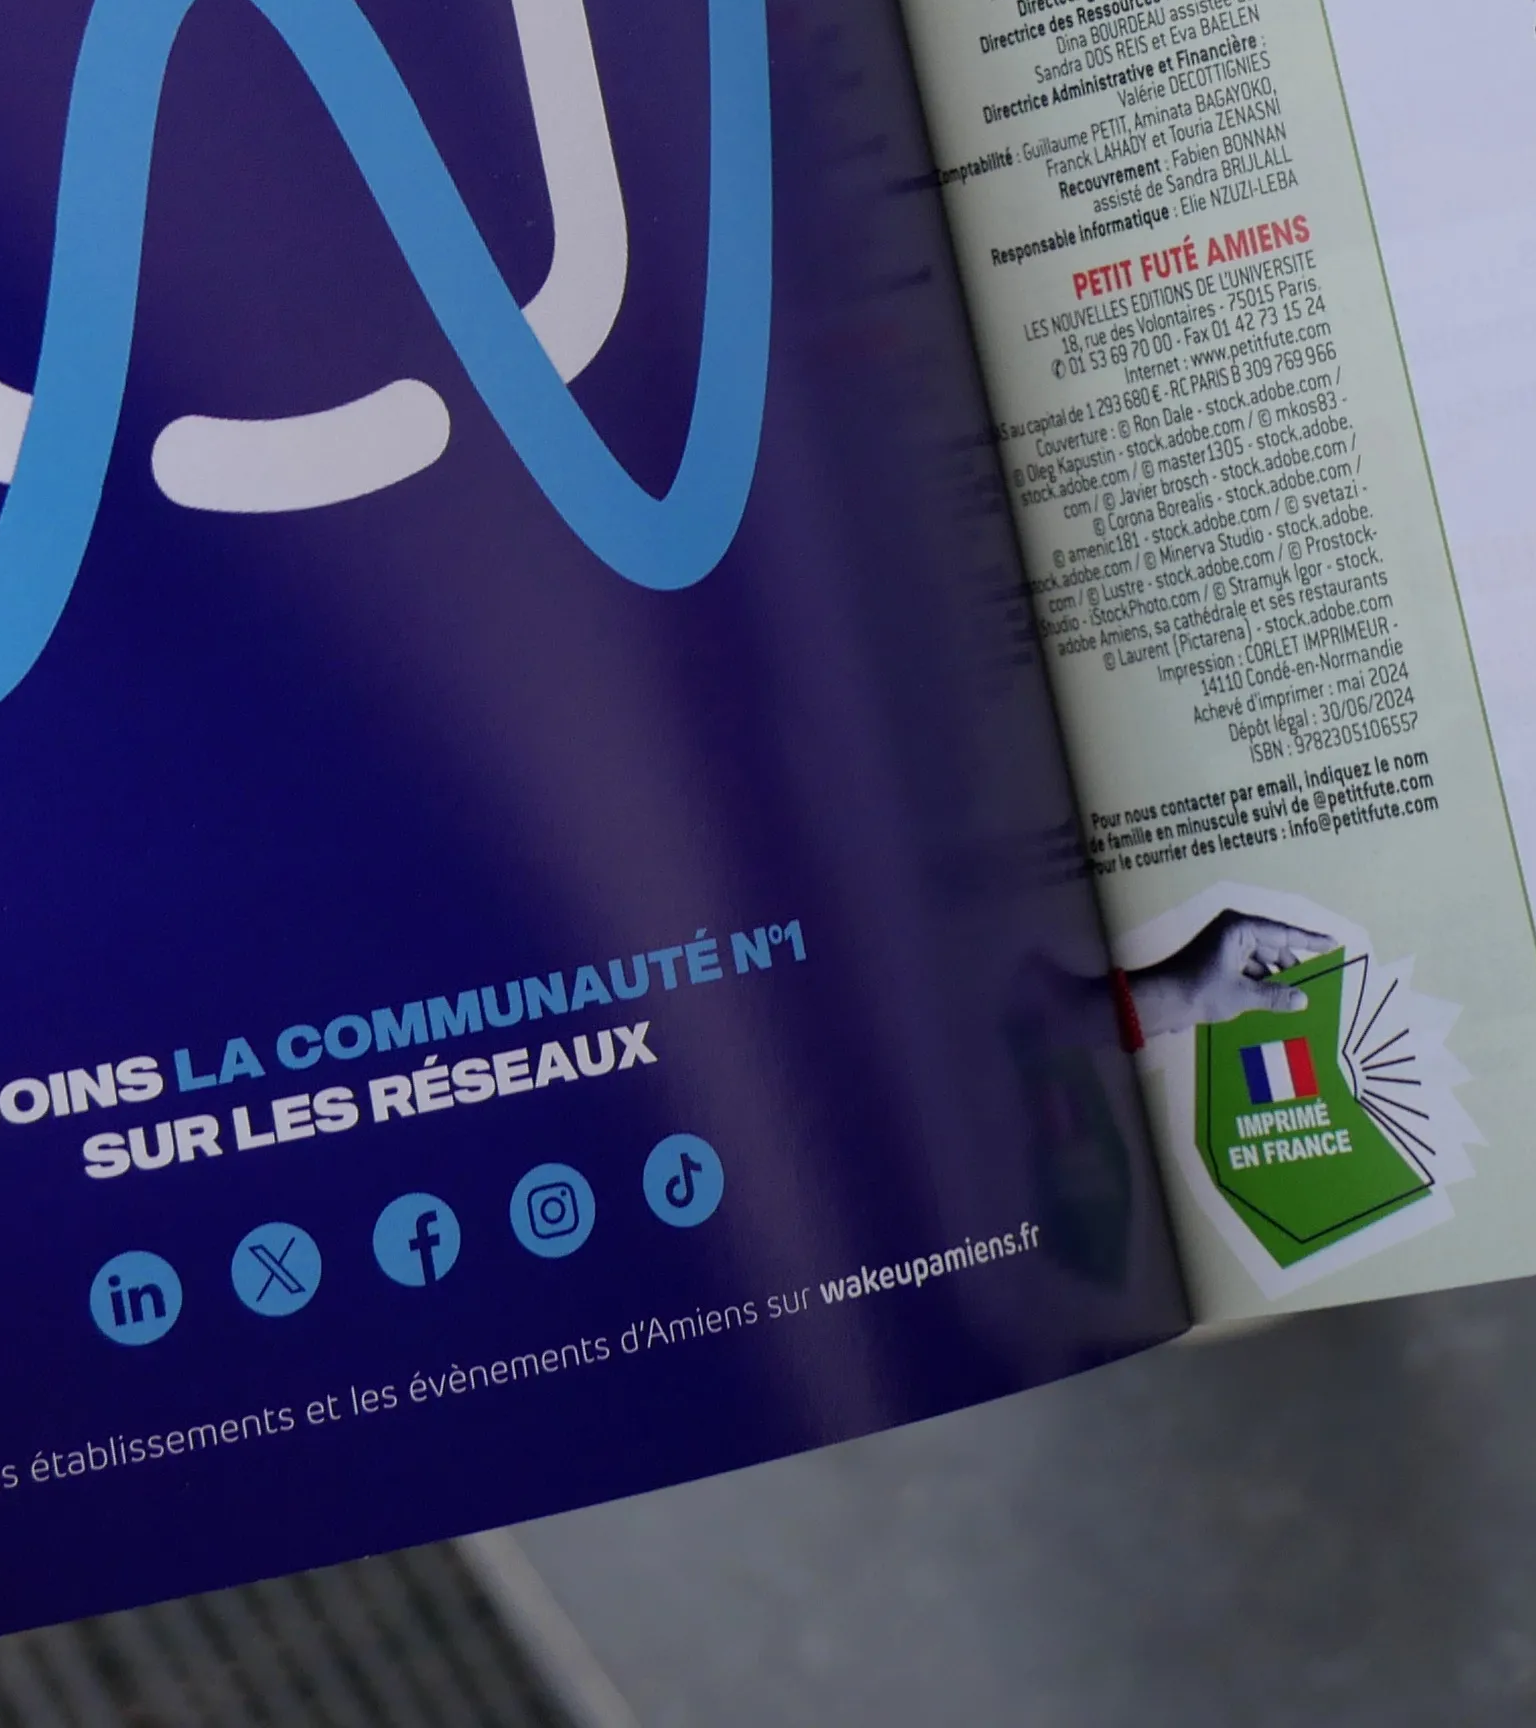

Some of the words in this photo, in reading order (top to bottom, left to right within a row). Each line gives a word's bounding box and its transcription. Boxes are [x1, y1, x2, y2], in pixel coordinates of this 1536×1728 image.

[1116, 80, 1166, 109] Valérie
[1167, 49, 1271, 96] DECOTTIGNIES
[1022, 317, 1050, 343] LES
[1050, 296, 1129, 335] NOUVELLES
[1129, 280, 1194, 314] EDITIONS
[1195, 273, 1218, 298] DE
[1217, 248, 1317, 292] L'UNIVERSITE
[1072, 259, 1133, 300] PETIT
[1141, 235, 1199, 283] FUTÉ
[1207, 214, 1312, 266] AMIENS
[1200, 669, 1244, 698] 14110
[1245, 637, 1404, 688] Condé-en-Normandie
[1090, 812, 1122, 831] Pour
[1123, 805, 1158, 825] nous
[1159, 791, 1226, 818] contacter
[1228, 785, 1253, 808] par
[1256, 771, 1303, 799] email,
[1303, 761, 1373, 789] indiquez
[1373, 754, 1390, 775] le
[1392, 750, 1430, 771] nom
[173, 1036, 265, 1092] LA
[276, 927, 723, 1069] COMMUNAUTÉ
[730, 919, 807, 974] N°1
[82, 1114, 223, 1180] SUR
[232, 1086, 359, 1151] LES
[368, 1020, 658, 1123] RÉSEAUX
[1235, 1098, 1331, 1139] IMPRIMÉ
[1228, 1146, 1260, 1171] EN
[1263, 1129, 1352, 1165] FRANCE
[30, 1407, 296, 1483] établissements
[305, 1393, 342, 1425] et
[350, 1384, 399, 1416] les
[408, 1336, 611, 1403] évènements
[620, 1300, 759, 1355] d'Amiens
[766, 1287, 810, 1319] sur
[819, 1220, 1040, 1305] wakeupamiens.fr
